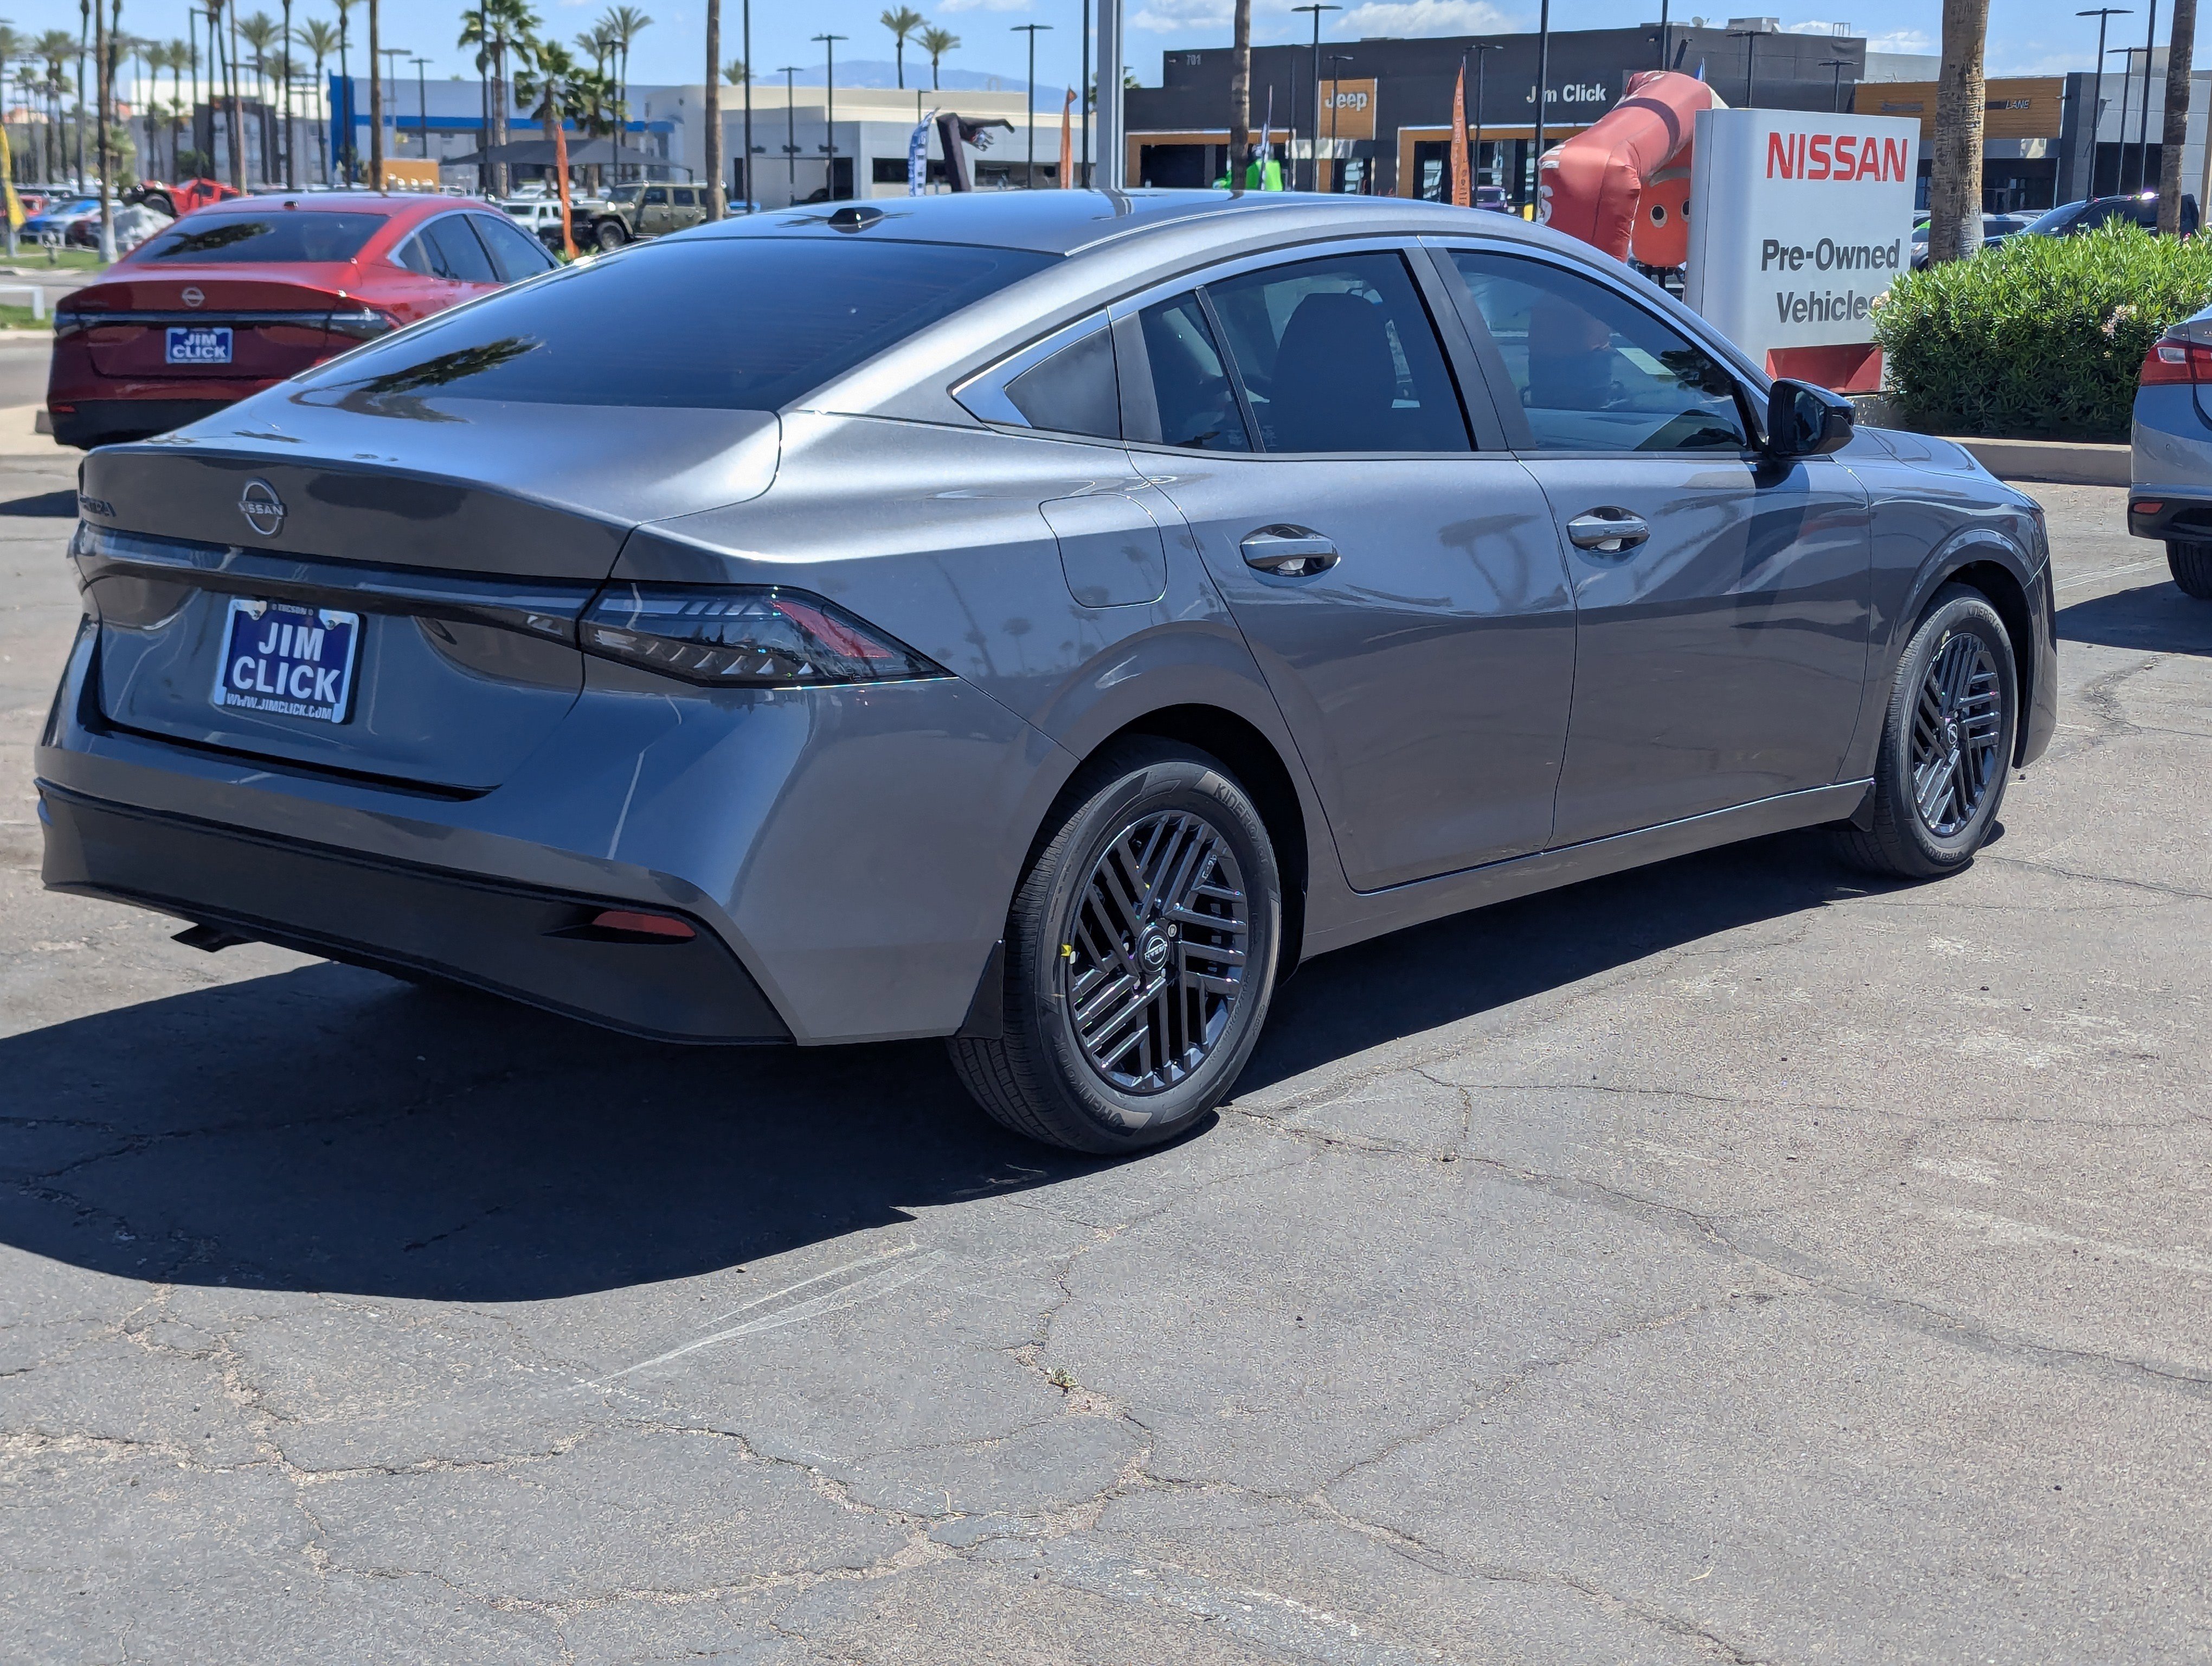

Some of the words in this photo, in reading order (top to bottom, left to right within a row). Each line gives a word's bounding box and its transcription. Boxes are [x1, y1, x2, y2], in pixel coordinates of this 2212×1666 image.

[1324, 88, 1367, 112] Jeep
[1526, 85, 1557, 103] Jm
[1562, 82, 1606, 102] Click
[1766, 132, 1908, 182] NISSAN
[1761, 238, 1900, 271] Pre-Owned
[172, 344, 226, 358] CLICK
[184, 334, 217, 346] JIM
[259, 622, 325, 662] JIM
[233, 656, 341, 703] CLICK
